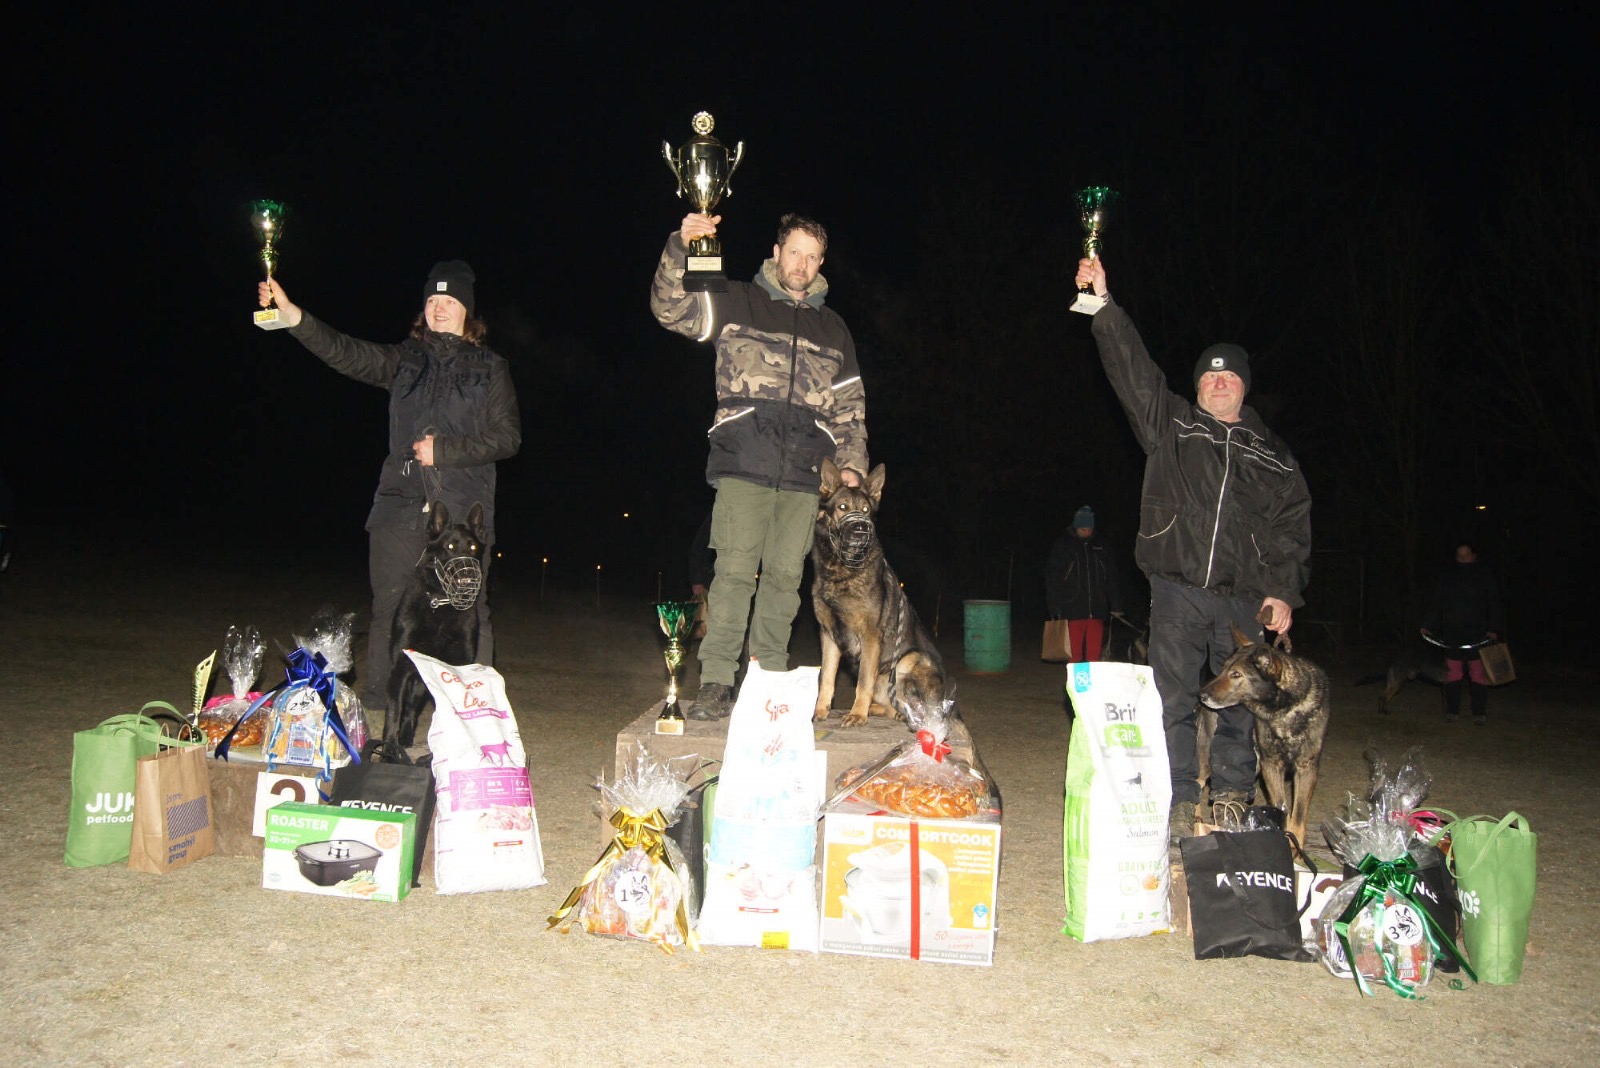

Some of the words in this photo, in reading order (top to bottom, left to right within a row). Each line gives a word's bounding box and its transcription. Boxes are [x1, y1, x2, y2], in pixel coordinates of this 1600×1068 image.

[85, 792, 135, 813] JUK
[86, 812, 134, 825] petfood
[270, 814, 329, 832] ROASTER
[876, 827, 993, 848] COMORTCOOK
